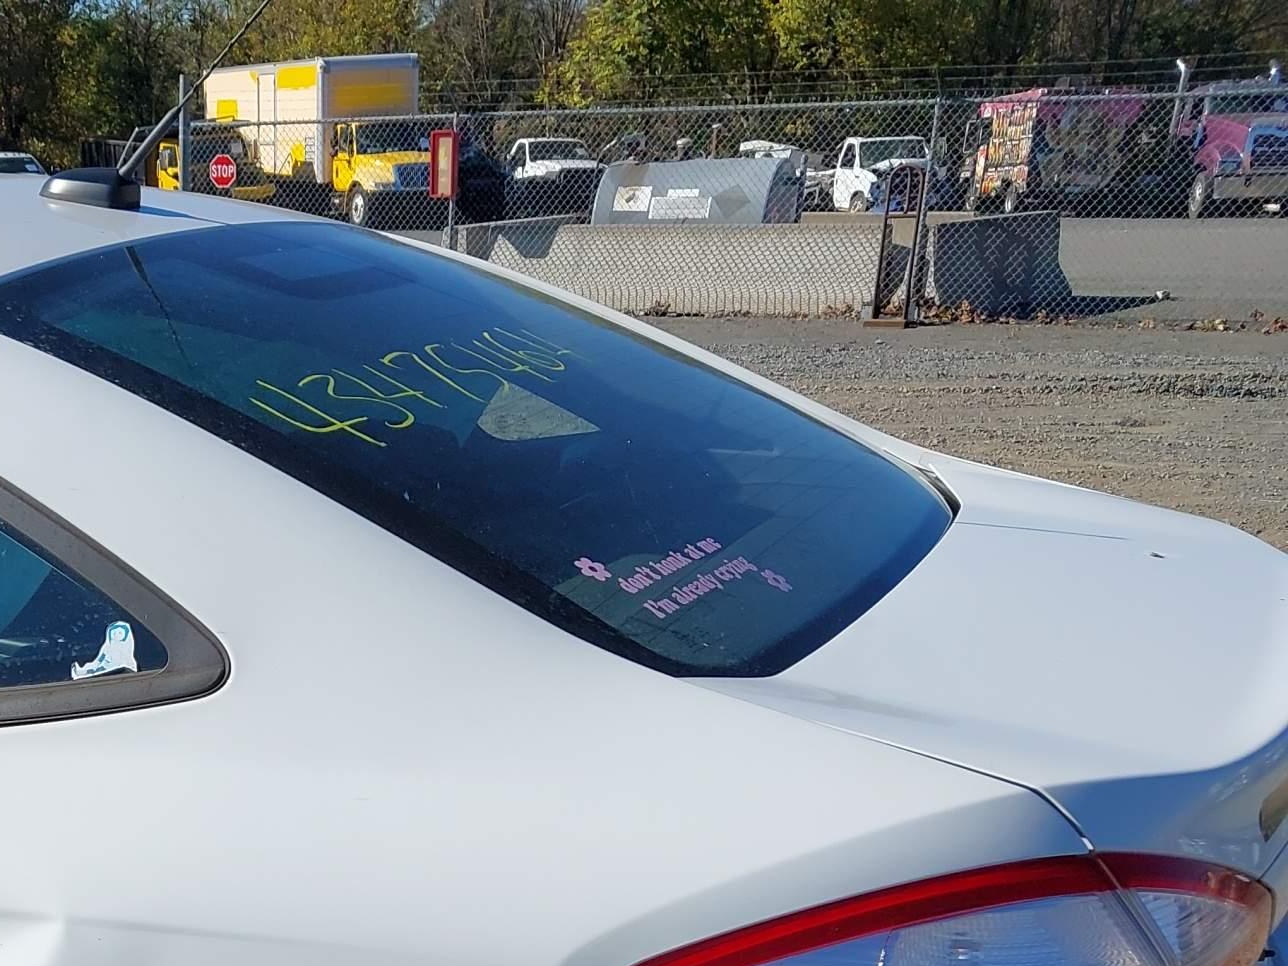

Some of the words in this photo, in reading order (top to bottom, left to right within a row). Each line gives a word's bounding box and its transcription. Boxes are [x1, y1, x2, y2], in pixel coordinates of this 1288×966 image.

[211, 164, 235, 178] STOP
[617, 566, 661, 594] don't
[649, 551, 692, 576] honk
[684, 543, 705, 560] at
[696, 537, 722, 554] me
[643, 599, 680, 619] I'm
[672, 573, 724, 605] already
[714, 556, 758, 580] crying
